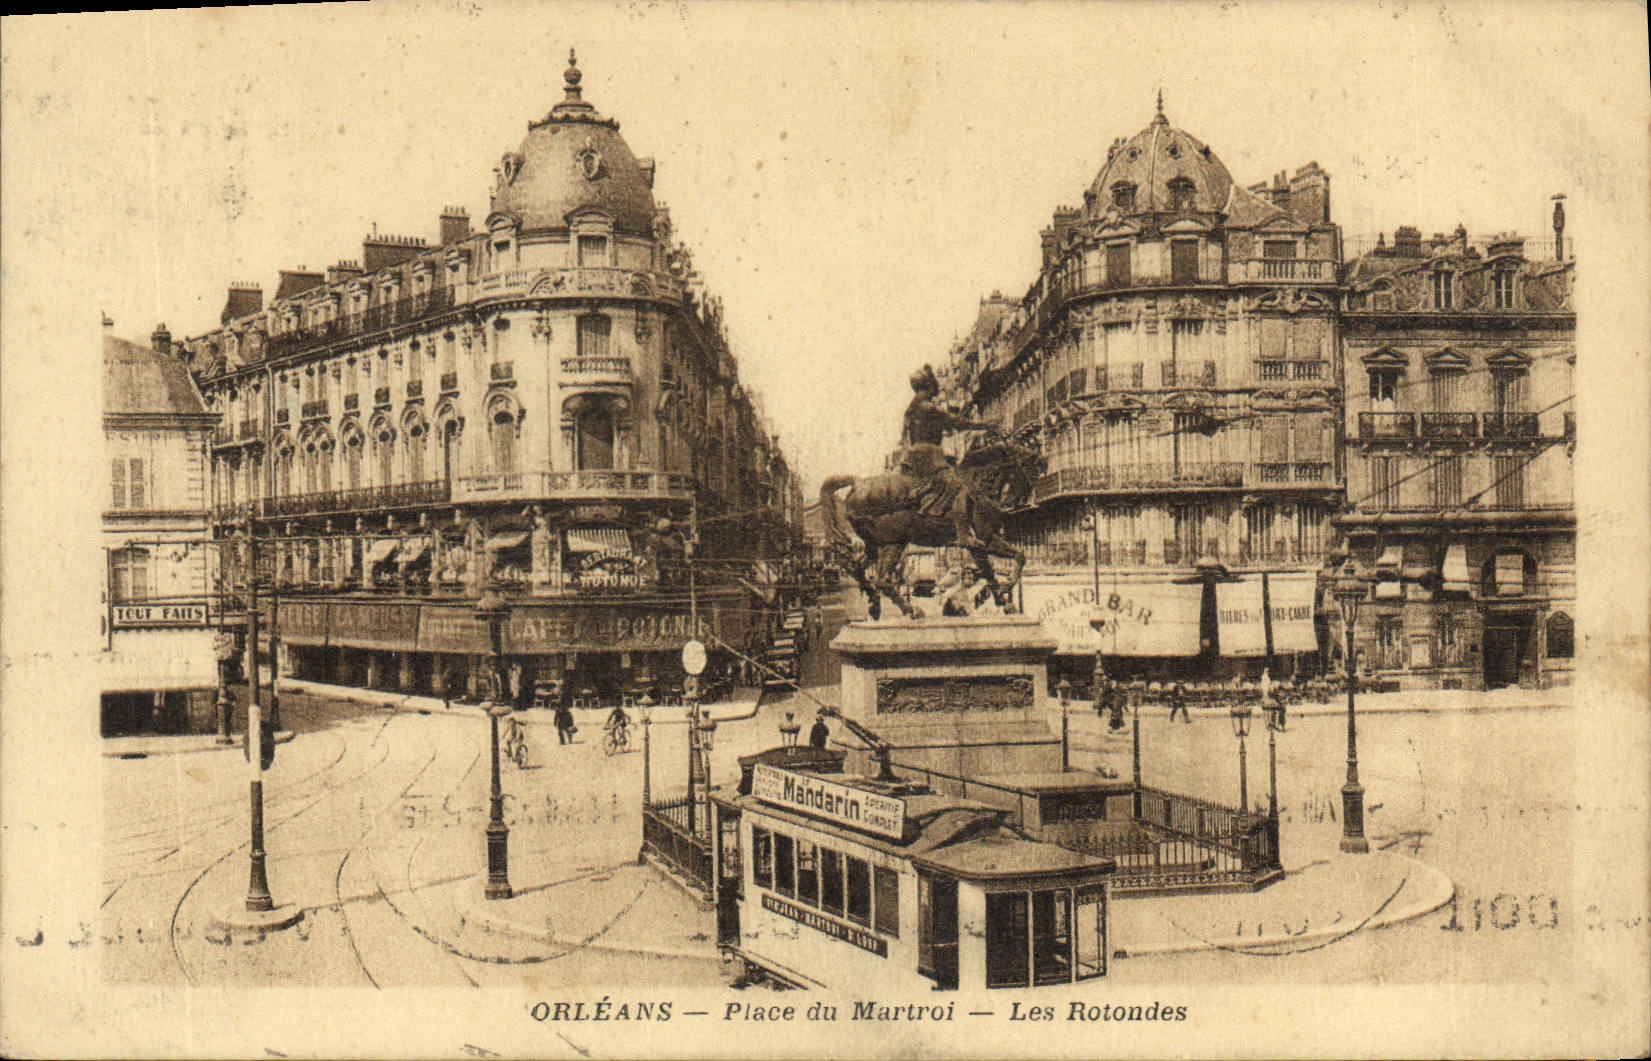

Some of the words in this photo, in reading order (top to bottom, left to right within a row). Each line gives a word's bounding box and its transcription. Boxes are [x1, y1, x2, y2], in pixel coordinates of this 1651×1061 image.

[118, 607, 152, 620] TOUT
[162, 607, 203, 620] FAITS
[1037, 587, 1095, 623] GRAND
[1107, 592, 1153, 626] BAR
[783, 775, 860, 821] Mandarin
